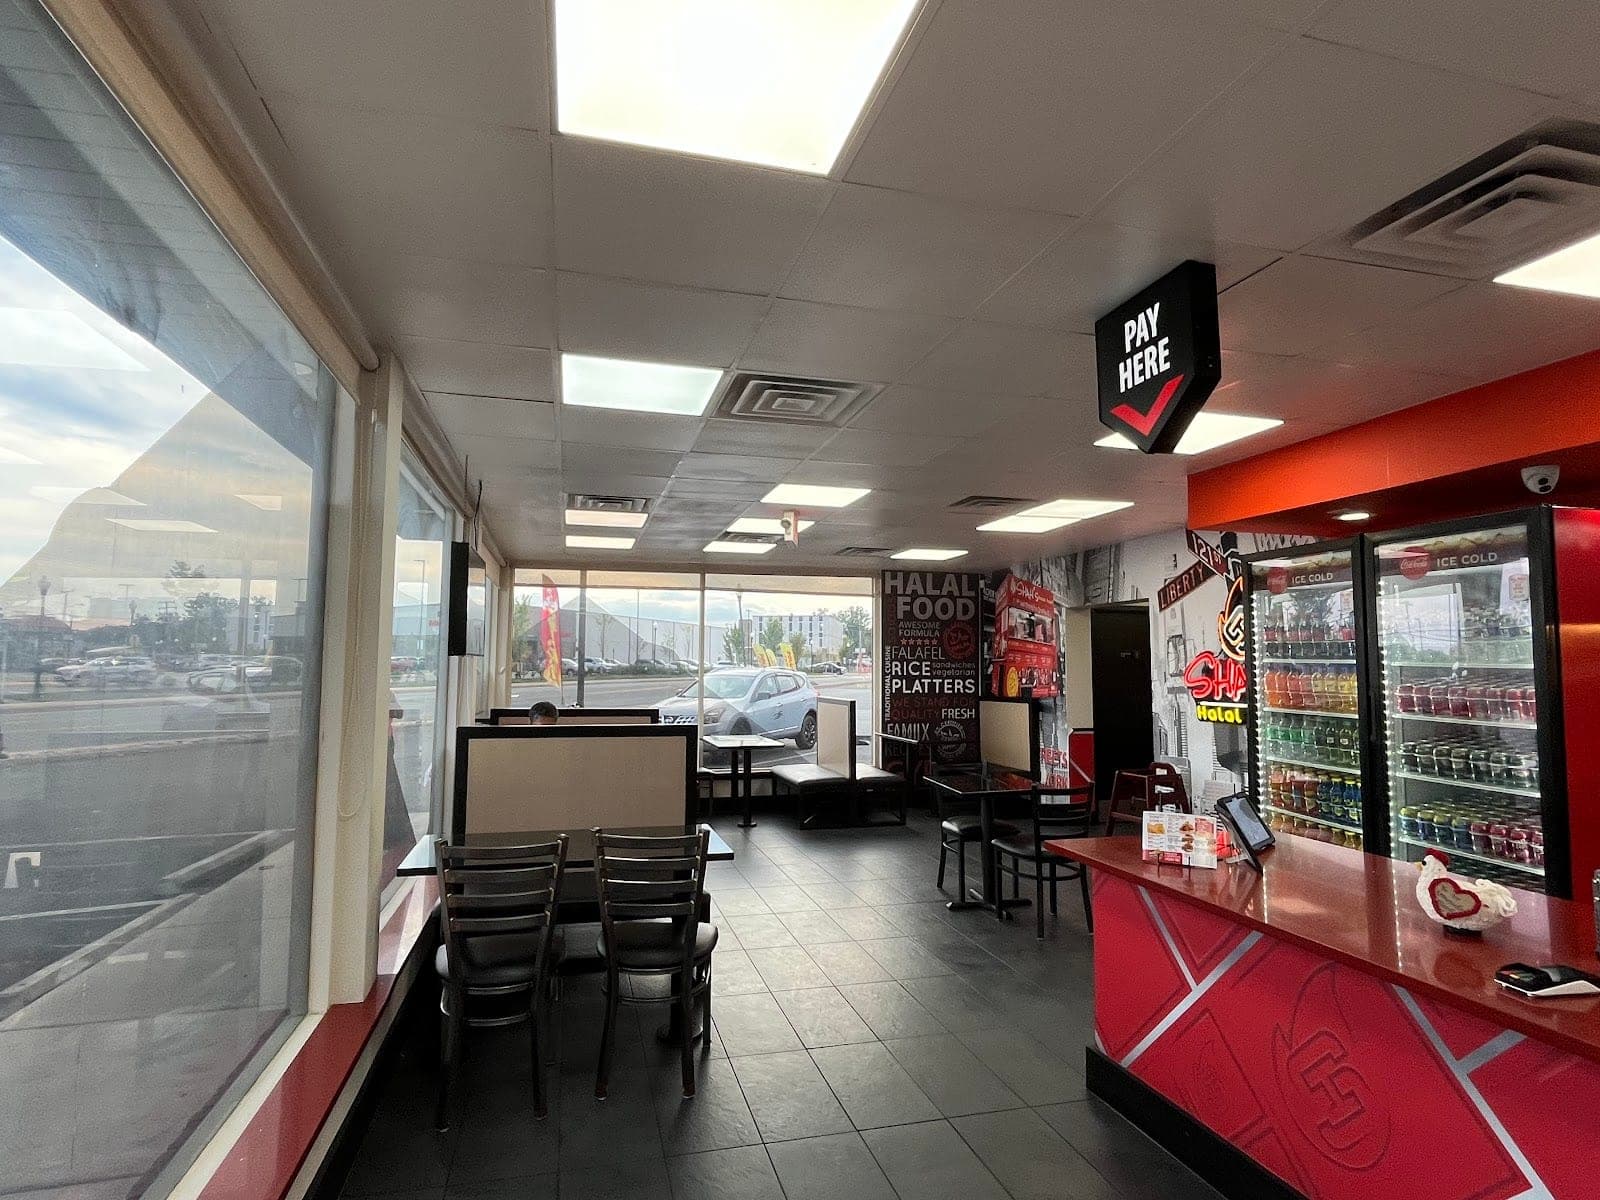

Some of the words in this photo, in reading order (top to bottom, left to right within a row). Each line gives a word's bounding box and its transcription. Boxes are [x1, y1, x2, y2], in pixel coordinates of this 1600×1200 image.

[1124, 302, 1160, 354] PAY
[1118, 336, 1171, 394] HERE
[1436, 555, 1457, 568] ICE
[1461, 552, 1498, 565] COLD
[884, 571, 975, 597] HALAL
[1291, 575, 1307, 584] ICE
[1308, 572, 1334, 583] COLD
[1159, 564, 1204, 608] LIBERTY
[897, 596, 975, 620] FOOD
[898, 621, 940, 629] AWESOME
[898, 629, 940, 637] FORMULA
[891, 646, 945, 660] FALAFEL
[891, 661, 931, 676] RICE
[931, 661, 976, 669] sandwiches
[932, 668, 976, 677] vegetarian
[891, 678, 976, 694] PLATTERS
[941, 708, 975, 719] FRESH
[1196, 705, 1243, 725] Halal
